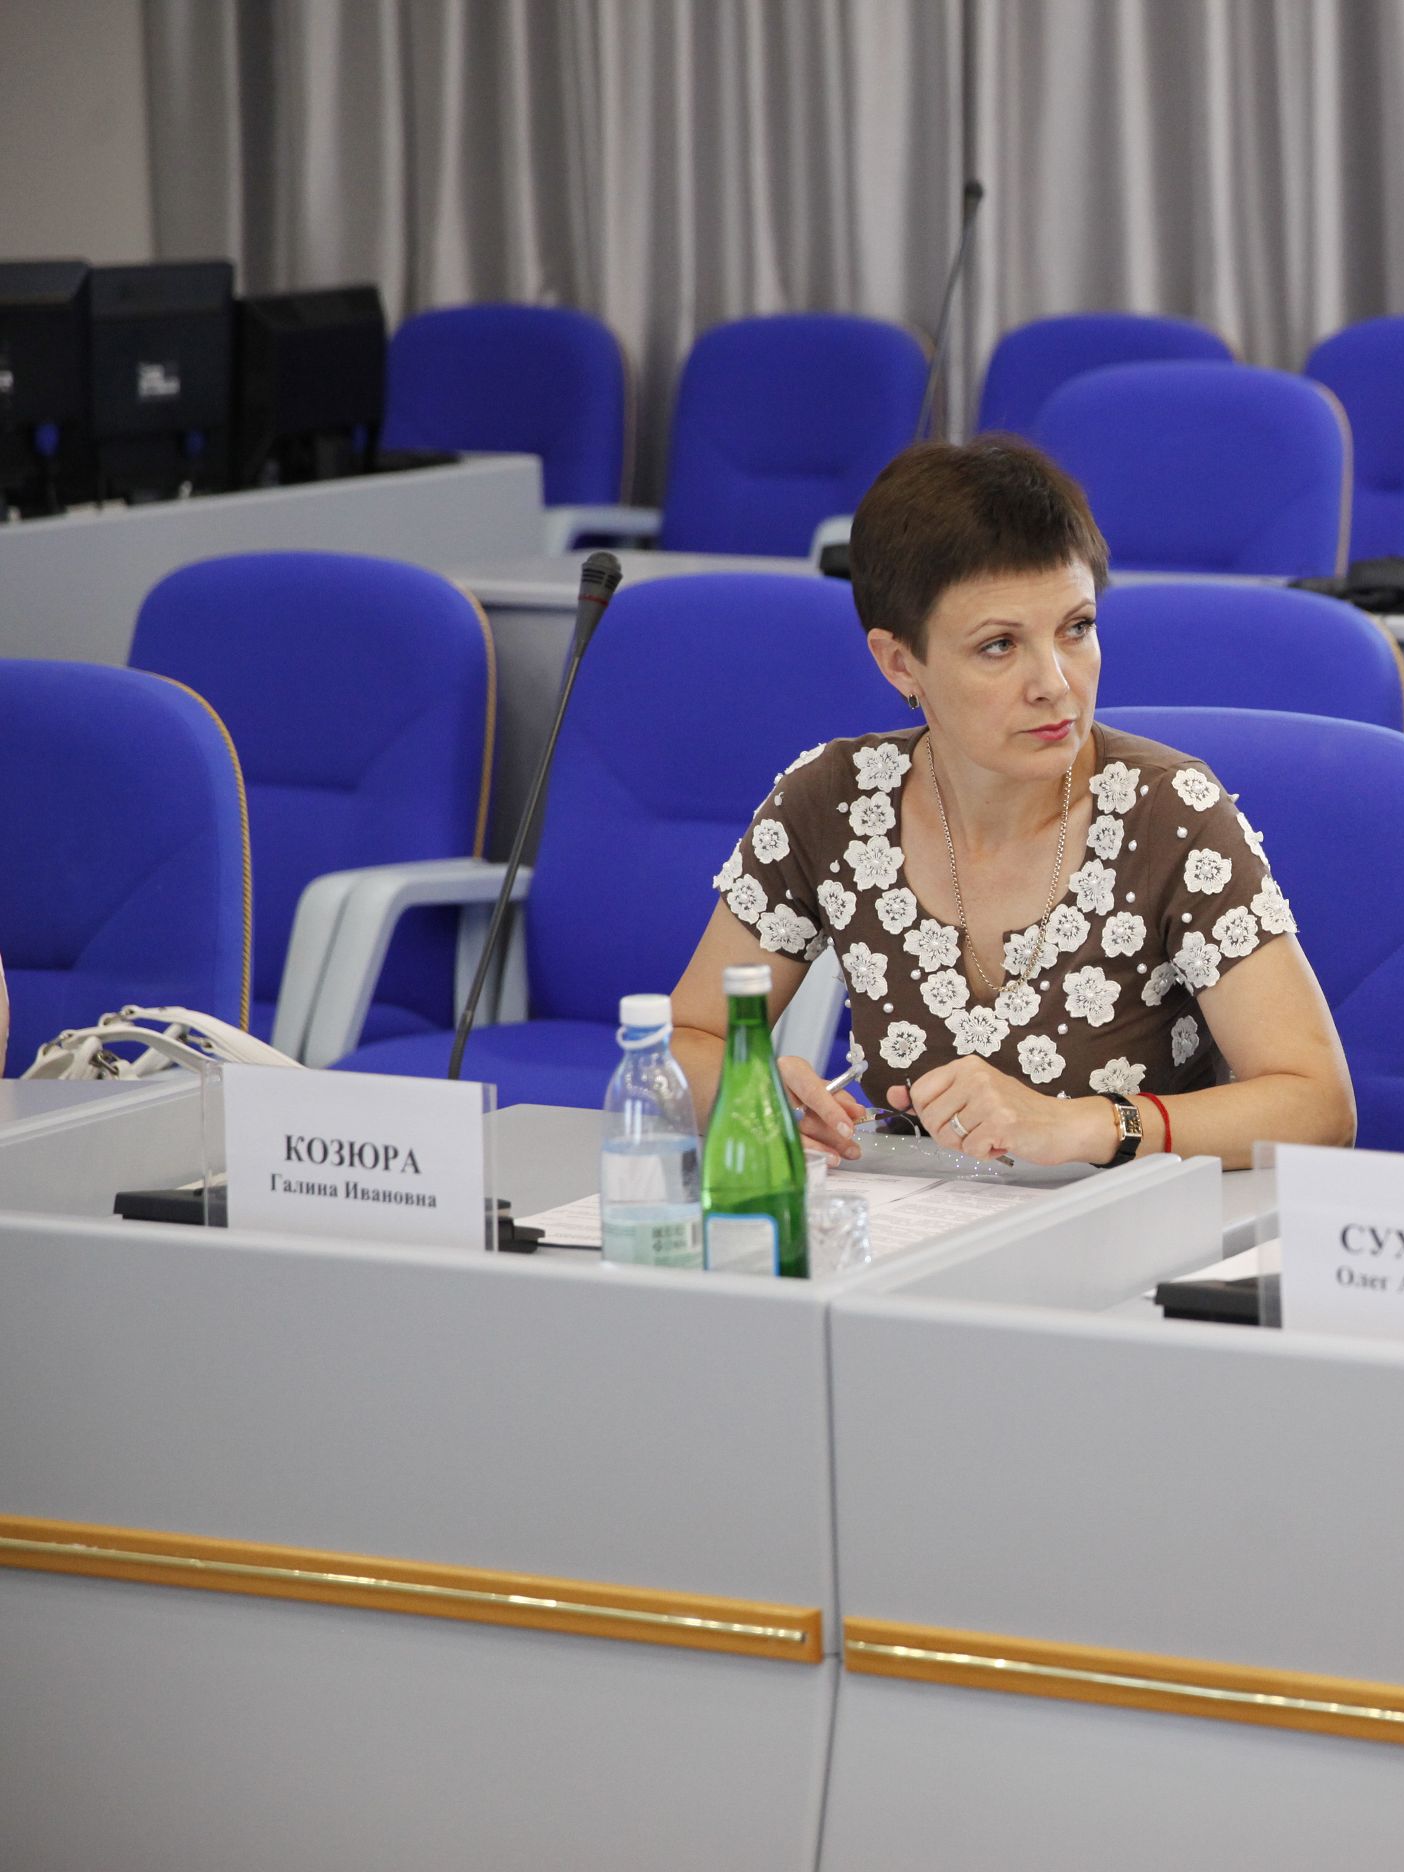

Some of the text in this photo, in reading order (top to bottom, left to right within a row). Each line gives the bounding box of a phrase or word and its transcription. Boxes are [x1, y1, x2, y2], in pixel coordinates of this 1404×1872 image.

[283, 1133, 422, 1175] КОЗЮРА
[270, 1172, 438, 1209] Галина Ивановна
[1335, 1266, 1388, 1291] Олег
